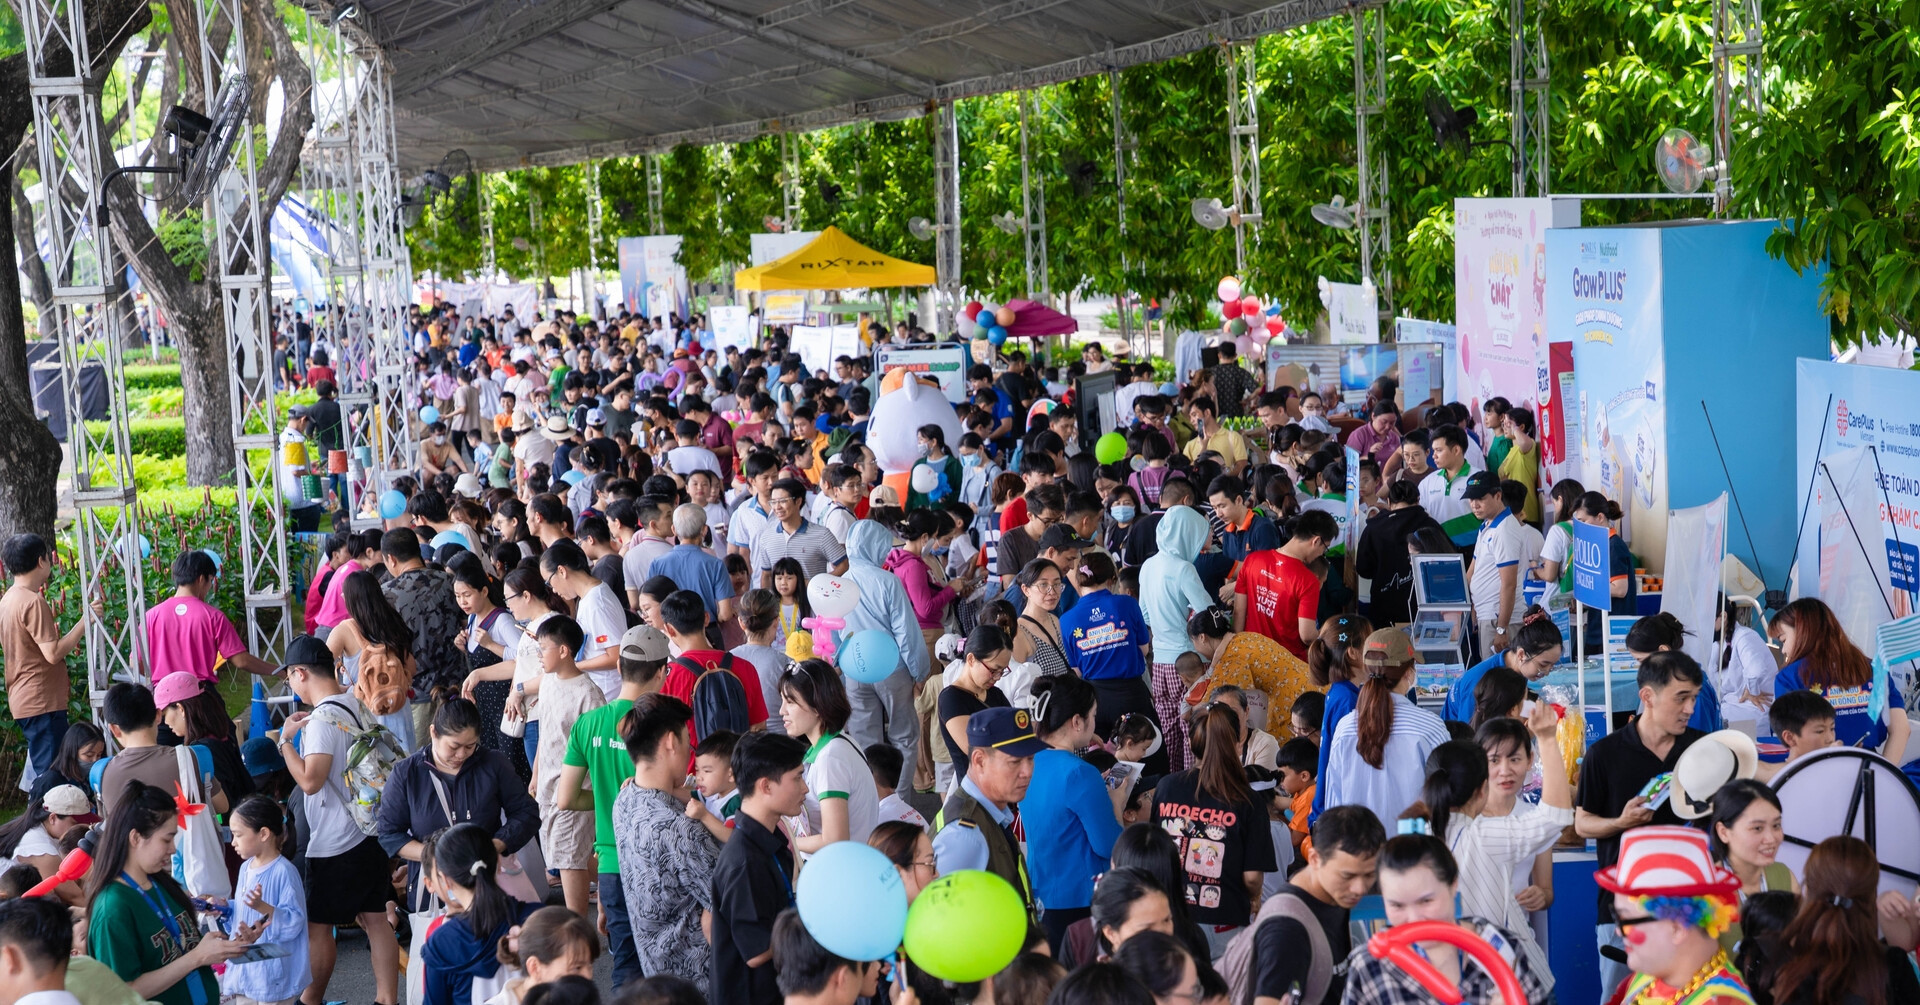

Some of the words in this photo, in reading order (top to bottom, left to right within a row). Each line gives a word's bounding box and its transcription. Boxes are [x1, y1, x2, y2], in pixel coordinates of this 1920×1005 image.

[801, 257, 884, 270] RIXTAR
[1848, 411, 1874, 431] CarePlus
[1891, 473, 1912, 497] TOÀN
[1888, 502, 1911, 529] KHÁM
[1574, 539, 1601, 569] POLLO
[1576, 571, 1595, 591] ENGLISH
[855, 641, 868, 673] KUMON
